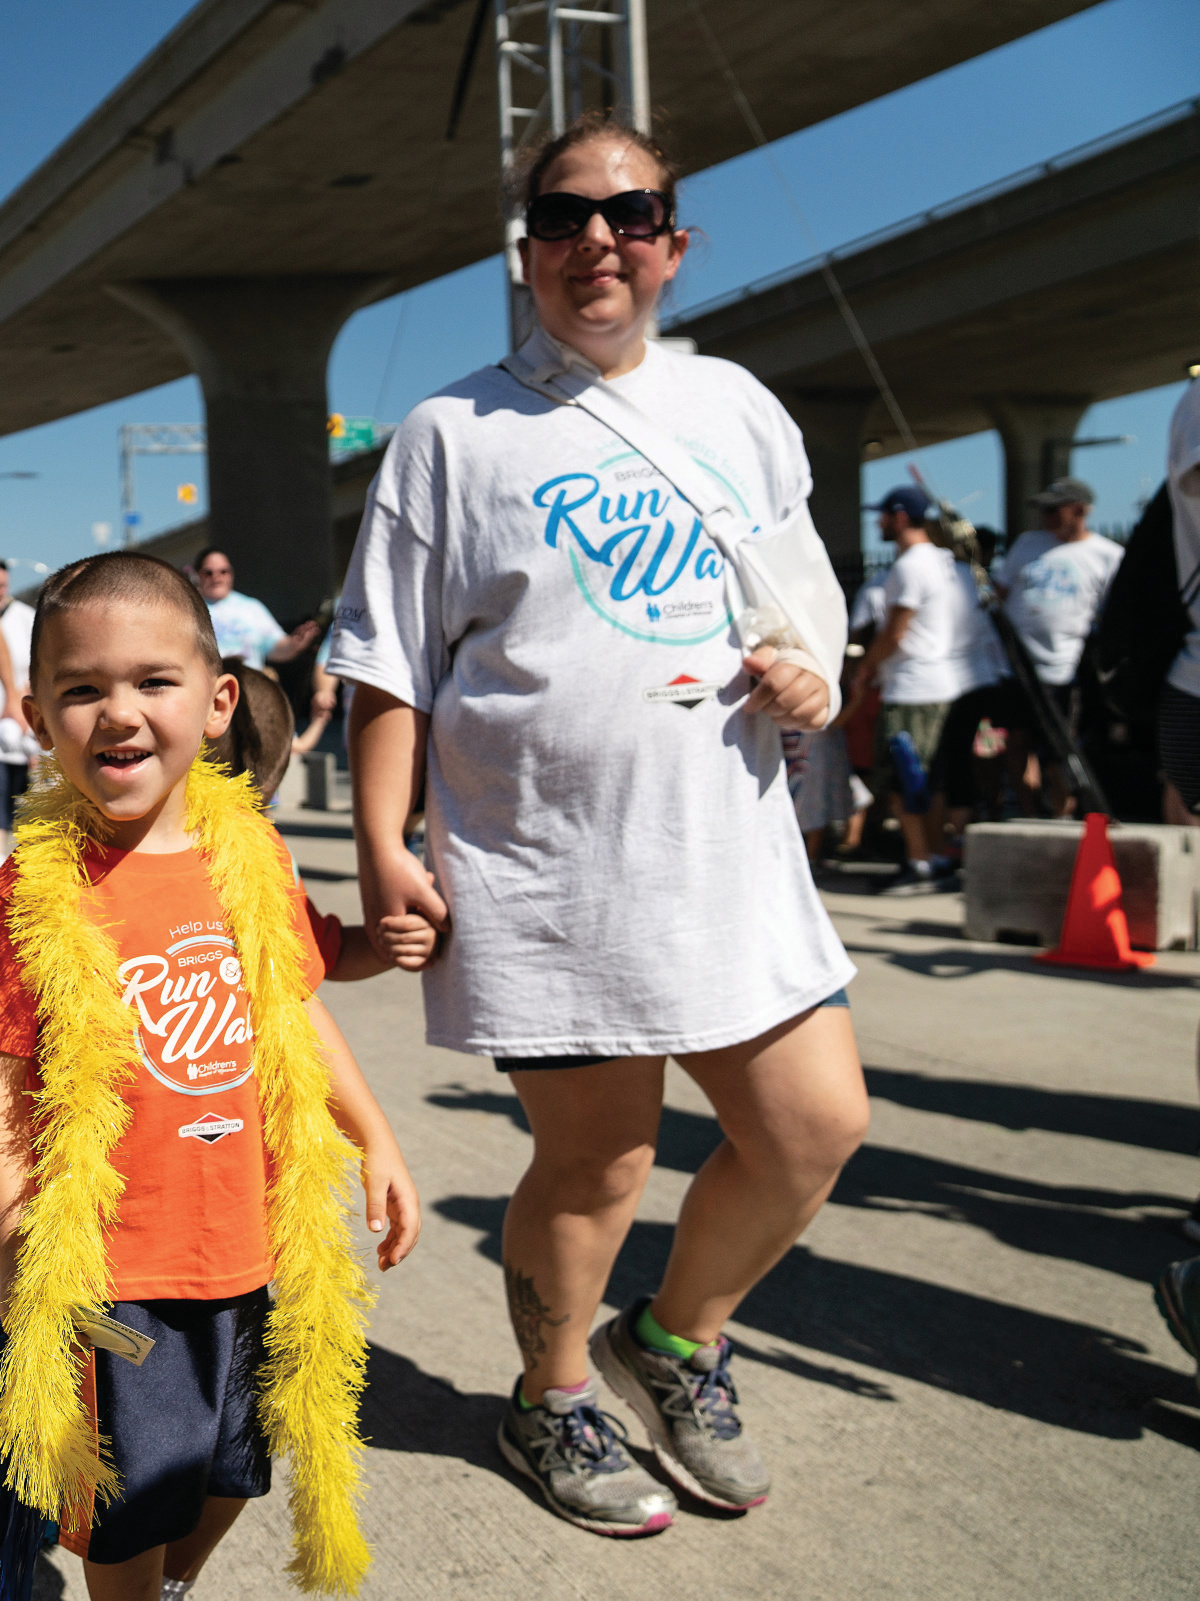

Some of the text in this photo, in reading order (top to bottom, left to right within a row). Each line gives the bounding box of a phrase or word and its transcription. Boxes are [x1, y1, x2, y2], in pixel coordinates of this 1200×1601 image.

[532, 473, 670, 562] Run
[606, 516, 724, 601] Wa
[646, 690, 680, 698] BRIGGS
[169, 920, 224, 939] Help us
[177, 949, 224, 968] BRIGGS
[116, 954, 218, 1034] Run
[158, 993, 253, 1063] Wal
[198, 1060, 237, 1074] Children's
[181, 1125, 205, 1134] BRIGGS
[209, 1122, 240, 1132] STRATTON
